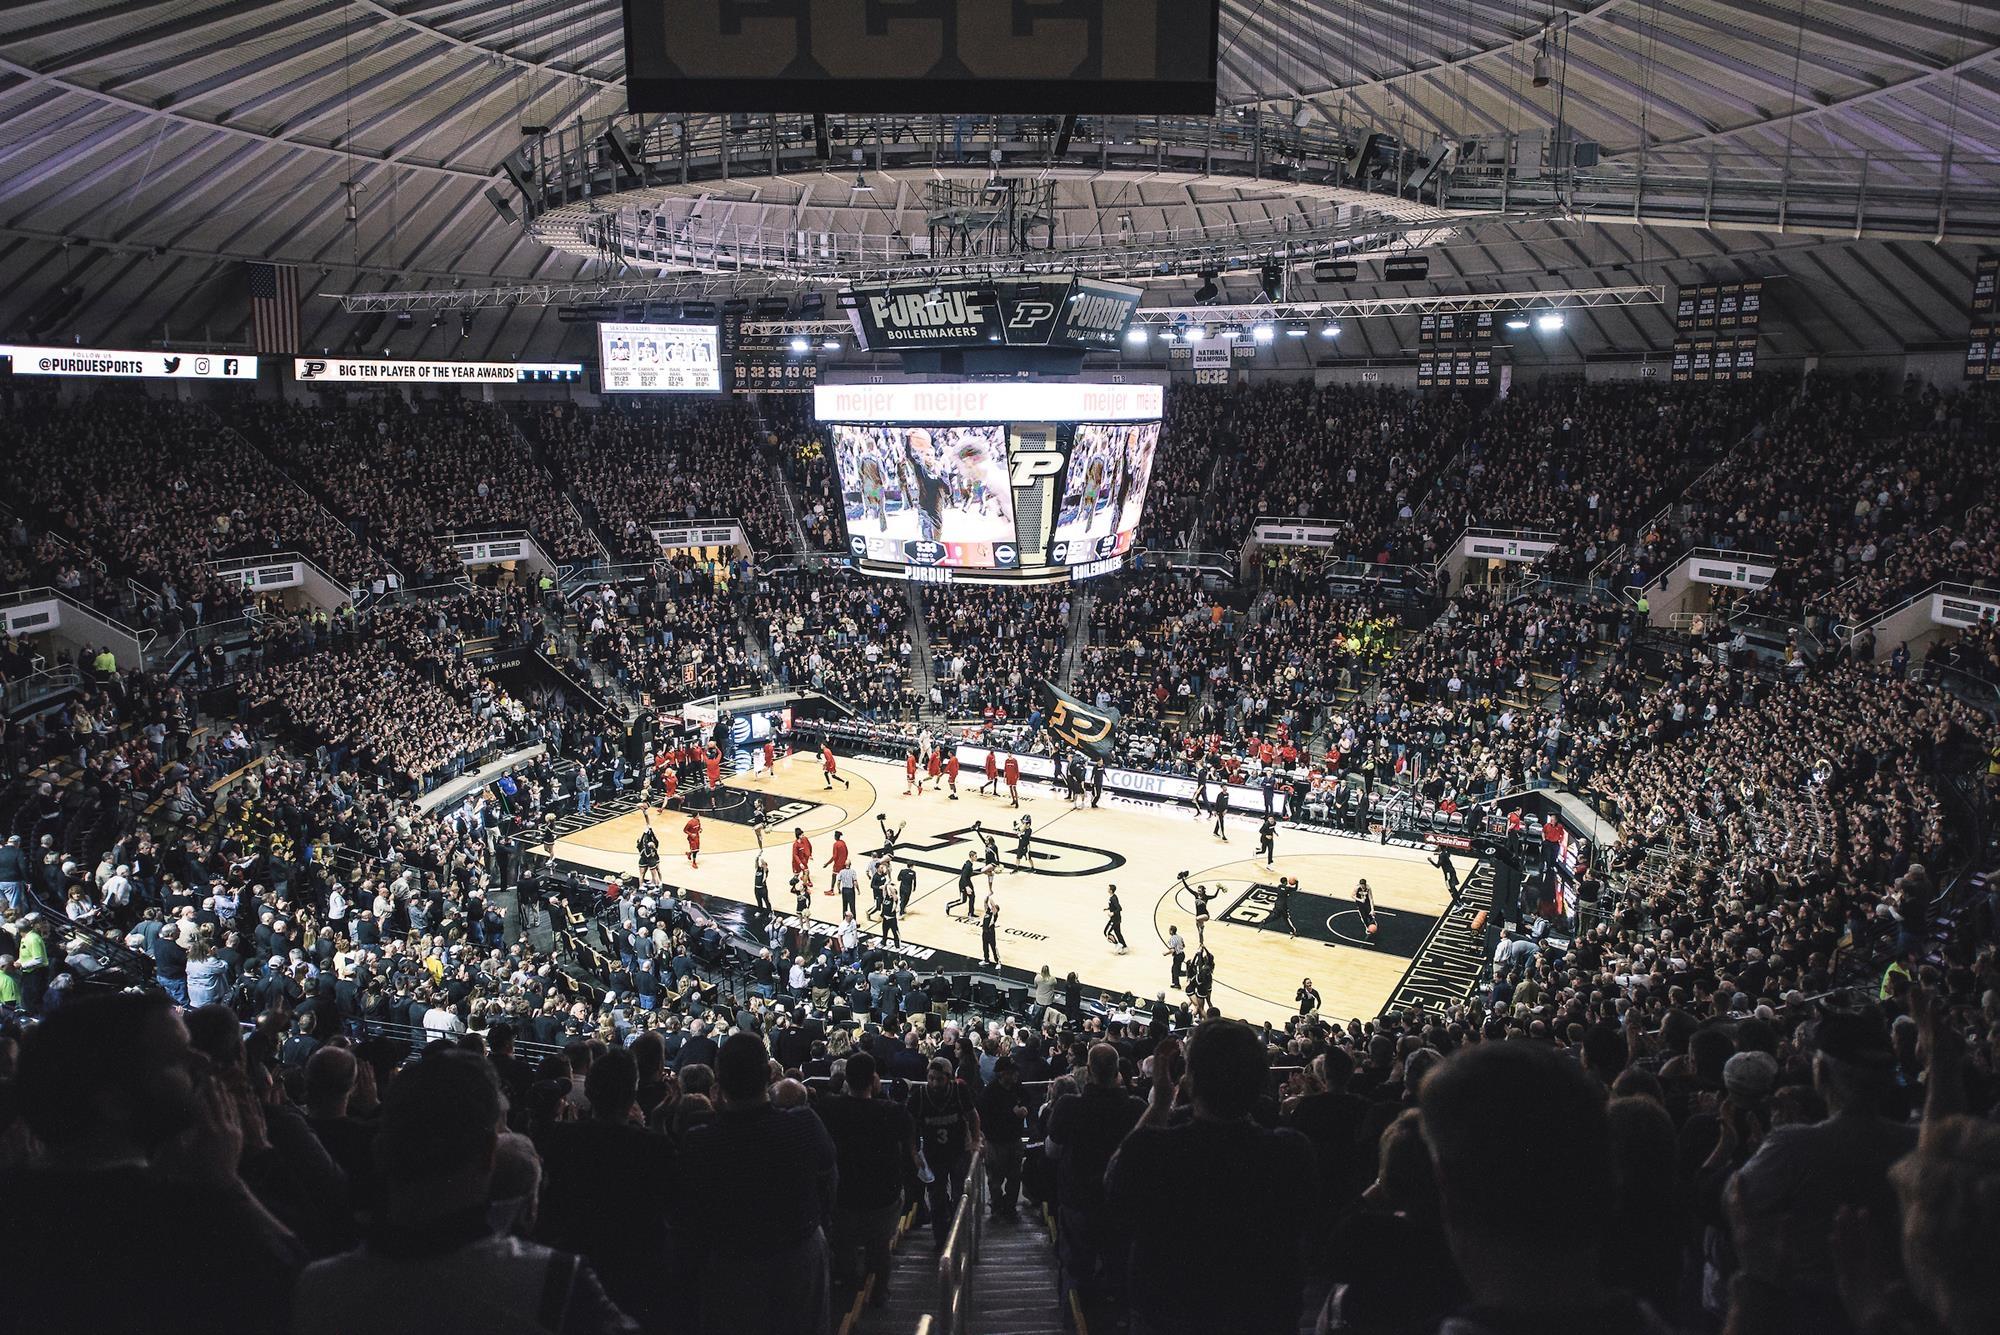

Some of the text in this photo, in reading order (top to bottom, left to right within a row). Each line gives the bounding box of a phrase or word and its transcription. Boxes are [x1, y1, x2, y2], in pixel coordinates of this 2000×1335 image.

[869, 290, 985, 328] PURDUE
[1066, 293, 1132, 331] PURDUE
[887, 327, 978, 340] BOILERMAKERS
[1170, 348, 1191, 359] 1969
[1233, 348, 1255, 357] 1980
[39, 357, 143, 373] @PURDUESPORTS
[339, 364, 514, 379] BIG TEN PLAYER OF THE YEAR AWARDS
[735, 366, 746, 378] 19
[751, 366, 765, 378] 32
[768, 366, 782, 378] 35
[785, 366, 800, 378] 43
[802, 366, 817, 378] 42
[1642, 368, 1657, 376] 102
[1195, 370, 1229, 384] 1932
[1364, 373, 1377, 381] 101
[836, 388, 894, 417] meijer
[913, 386, 988, 417] meijer
[1083, 387, 1128, 417] meijer
[905, 566, 953, 582] PURDUE
[1072, 556, 1123, 580] BOILERMAKERS
[483, 663, 500, 673] PLAY
[501, 659, 521, 669] HARD
[1111, 772, 1166, 793] COURT
[1004, 927, 1051, 942] COURT
[936, 1128, 949, 1145] 3
